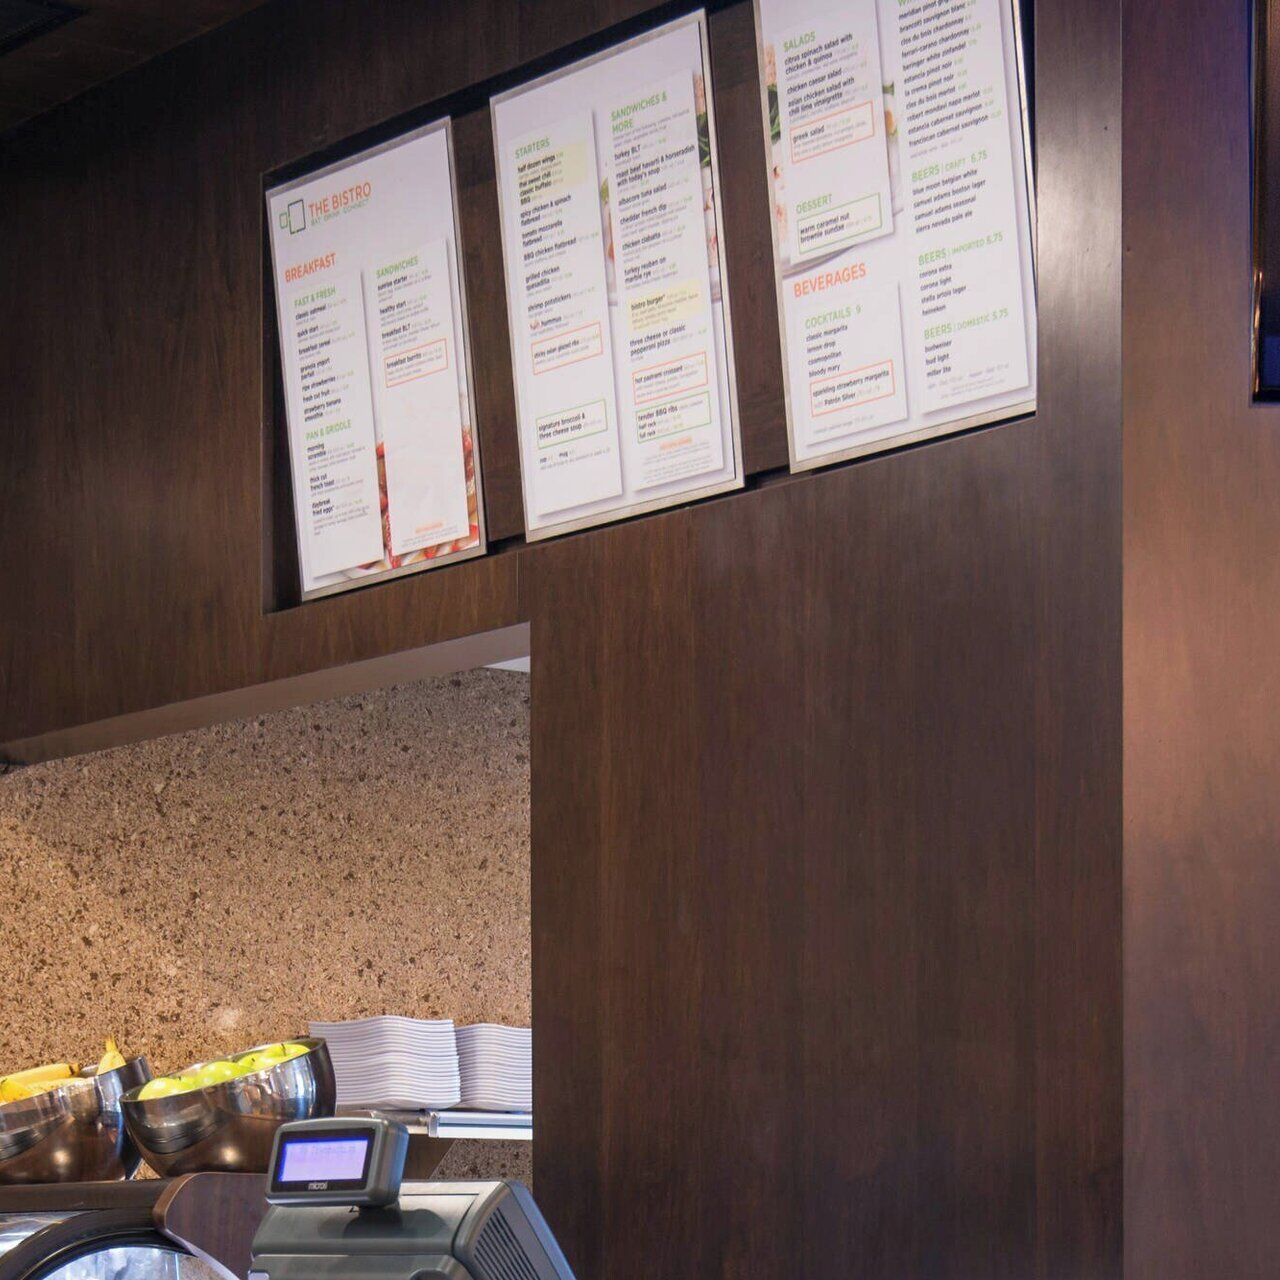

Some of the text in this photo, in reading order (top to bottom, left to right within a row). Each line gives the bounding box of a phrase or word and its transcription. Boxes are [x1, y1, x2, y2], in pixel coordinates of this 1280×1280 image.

[933, 17, 963, 33] chardonnay
[783, 31, 815, 52] SALADS
[938, 28, 969, 44] chardonnay
[784, 33, 852, 65] citrus spinach salad with
[785, 61, 806, 74] chicken
[813, 52, 832, 64] quinoa
[787, 67, 841, 94] chicken caesar salad
[928, 77, 941, 88] pinot
[943, 73, 954, 82] noir
[611, 94, 659, 120] SANDWICHES
[611, 118, 632, 134] MORE
[792, 125, 824, 143] greek salad
[515, 137, 549, 158] STARTERS
[614, 144, 640, 160] turkey BLT
[517, 163, 526, 172] half
[541, 154, 555, 163] wings
[911, 164, 939, 182] BEERS
[970, 149, 987, 163] 6.75
[308, 197, 329, 216] THE
[331, 182, 371, 209] BISTRO
[795, 193, 831, 213] DESSERT
[913, 196, 932, 208] samuel
[933, 191, 950, 202] adams
[971, 179, 985, 188] lager
[620, 213, 640, 224] cheddar
[641, 206, 657, 216] french
[800, 212, 849, 234] warm caramel nut
[800, 223, 844, 243] brownie sundae
[622, 239, 640, 250] chicken
[918, 247, 946, 265] BEERS
[986, 231, 1002, 244] 6.75
[285, 253, 334, 282] BREAKFAST
[376, 255, 417, 278] SANDWICHES
[525, 266, 559, 283] grilled chicken
[919, 263, 952, 278] corona extra
[794, 263, 865, 297] BEVERAGES
[920, 276, 951, 291] corona light
[294, 295, 308, 307] FAST
[315, 286, 335, 298] FRESH
[379, 305, 395, 314] healthy
[805, 306, 851, 328] COCKTAILS
[381, 327, 401, 338] breakfast
[924, 322, 951, 339] BEERS
[807, 351, 841, 365] cosmopolitan
[808, 367, 826, 377] bloody
[864, 370, 889, 381] margarita
[305, 430, 318, 440] PAN
[325, 419, 351, 434] GRIDDLE
[552, 427, 569, 435] cheese
